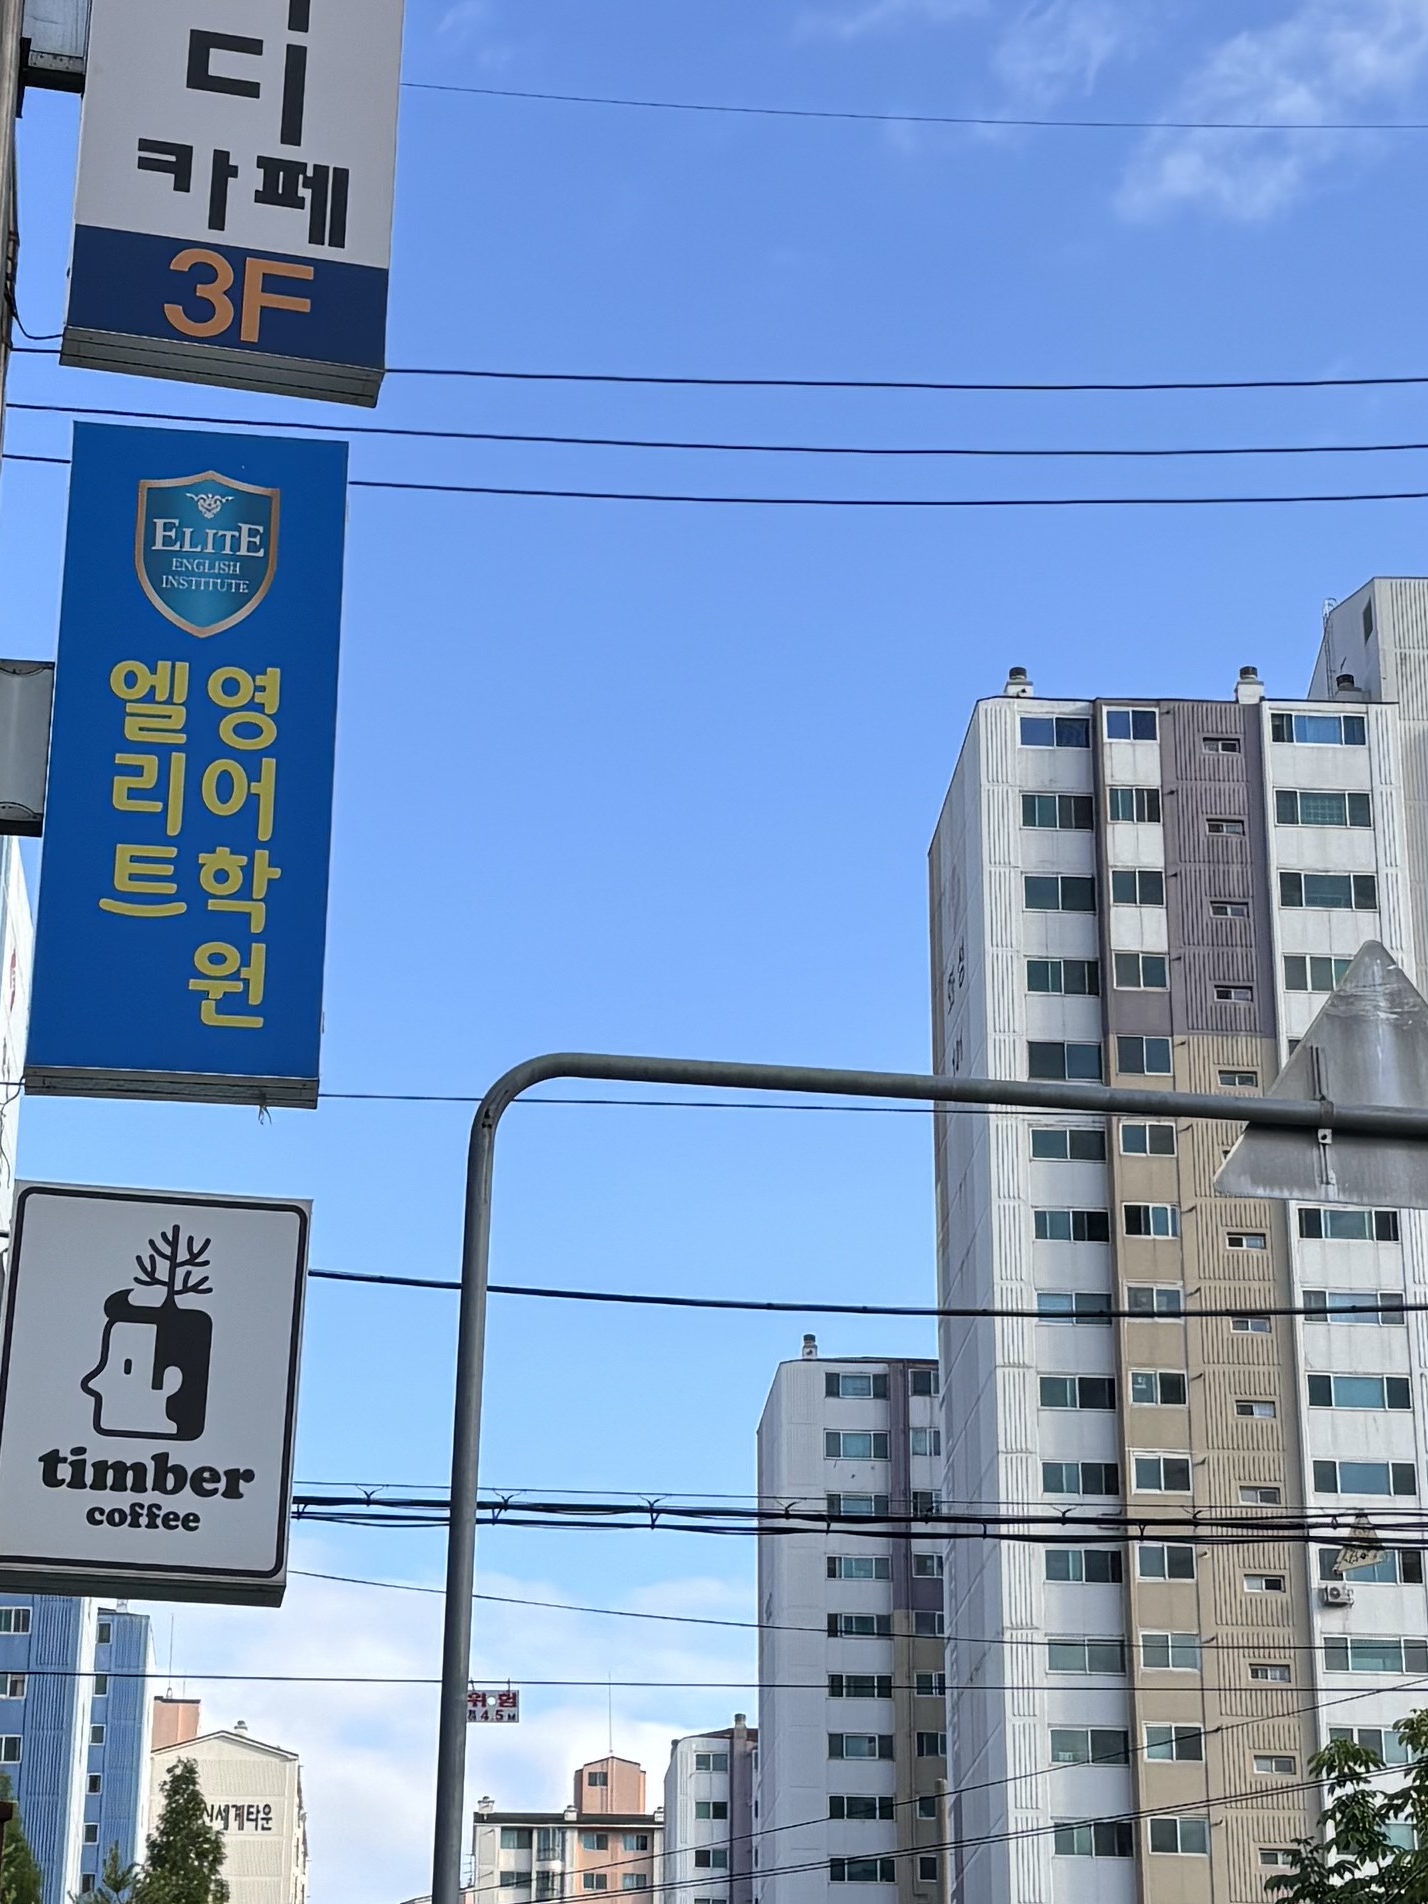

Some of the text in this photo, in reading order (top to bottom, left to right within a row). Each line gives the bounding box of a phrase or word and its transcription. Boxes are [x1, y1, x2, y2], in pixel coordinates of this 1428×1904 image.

[137, 137, 350, 249] 카페
[163, 247, 315, 344] 3F
[150, 517, 266, 559] ELITE
[170, 556, 242, 576] ENGLISH
[160, 573, 251, 594] INSTITUTE
[98, 659, 189, 917] 엘리트
[187, 665, 282, 1030] 영어학원
[37, 1444, 256, 1500] timber
[85, 1501, 202, 1533] coffee
